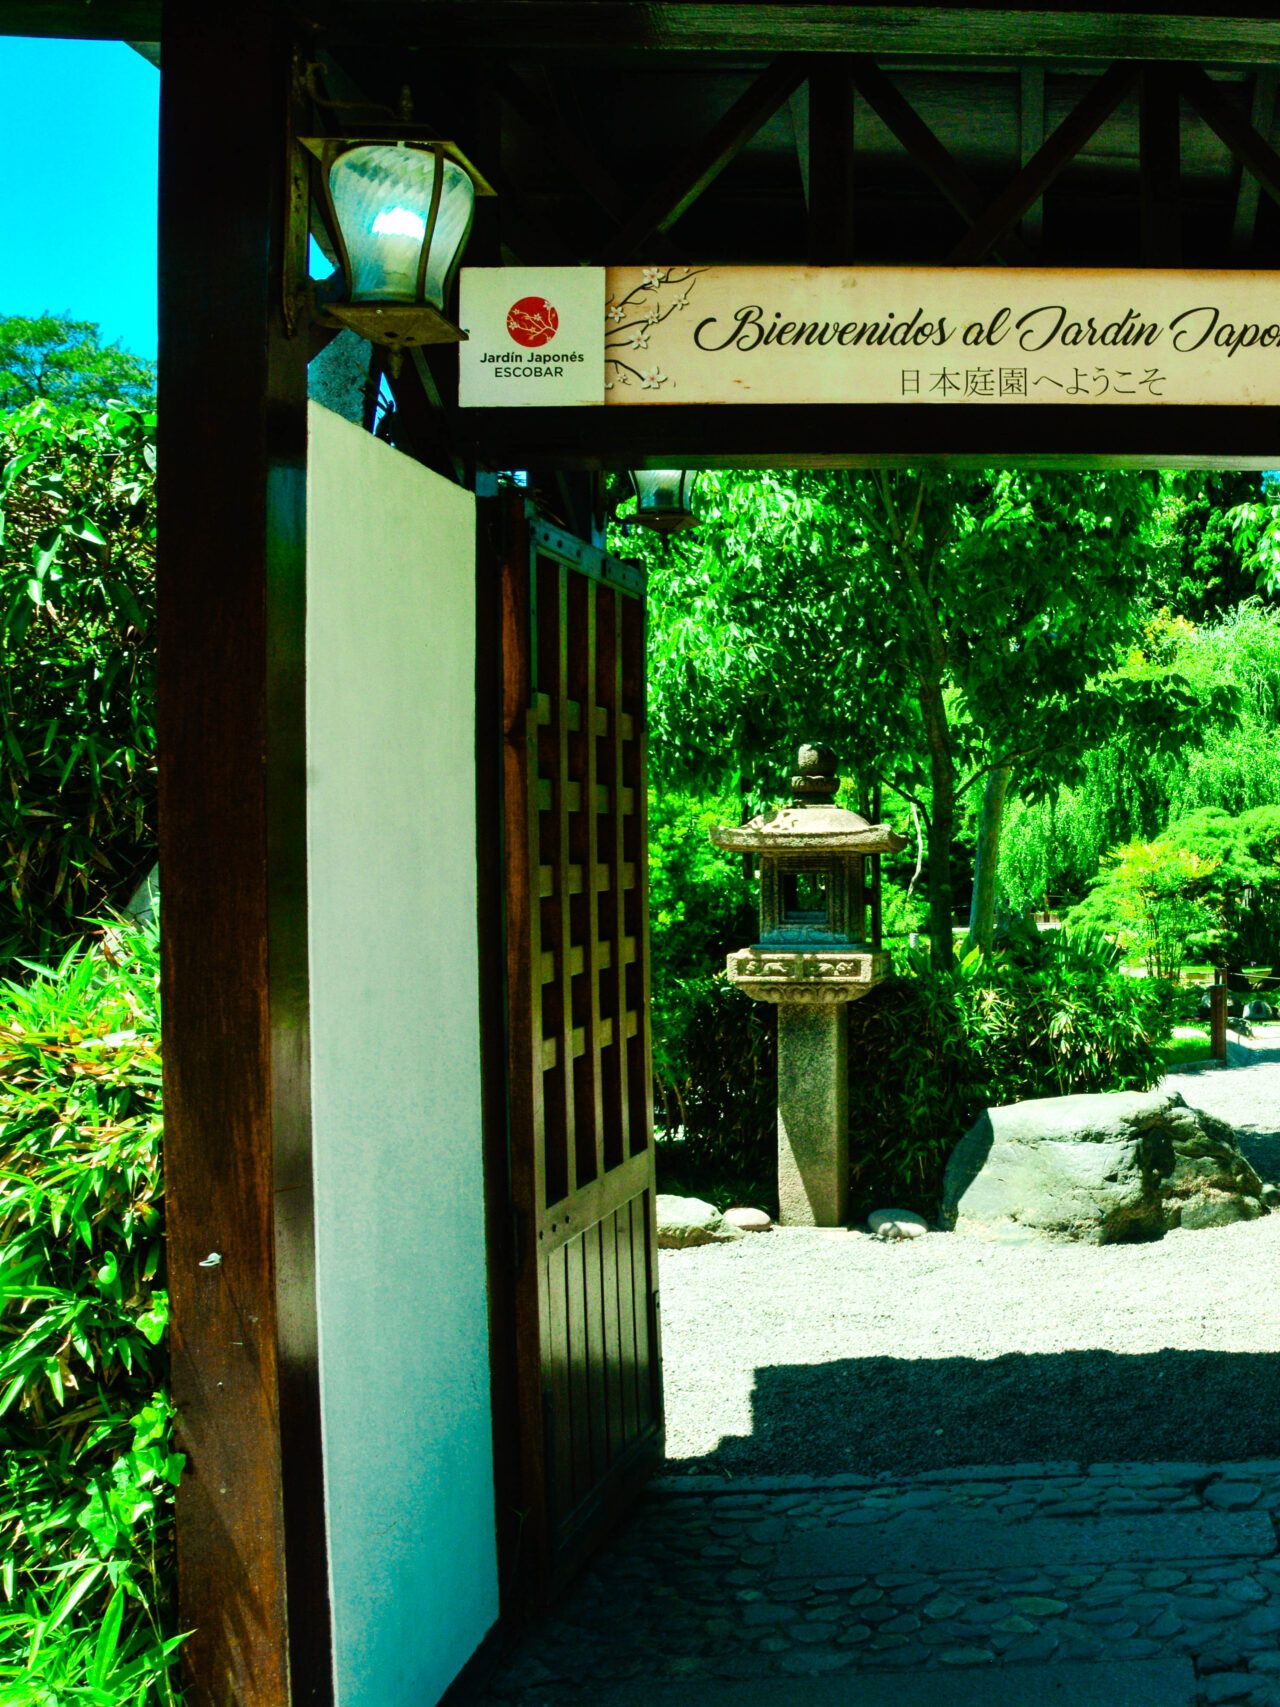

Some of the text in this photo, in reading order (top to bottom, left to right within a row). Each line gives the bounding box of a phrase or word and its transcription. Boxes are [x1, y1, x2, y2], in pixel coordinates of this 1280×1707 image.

[694, 305, 957, 351] Bienvenidos
[962, 308, 1010, 345] al
[1015, 306, 1164, 351] Jardín
[480, 350, 584, 366] Jardín Japonés
[494, 367, 563, 378] ESCOBAR
[899, 368, 1168, 399] 日本庭園へようこそ
